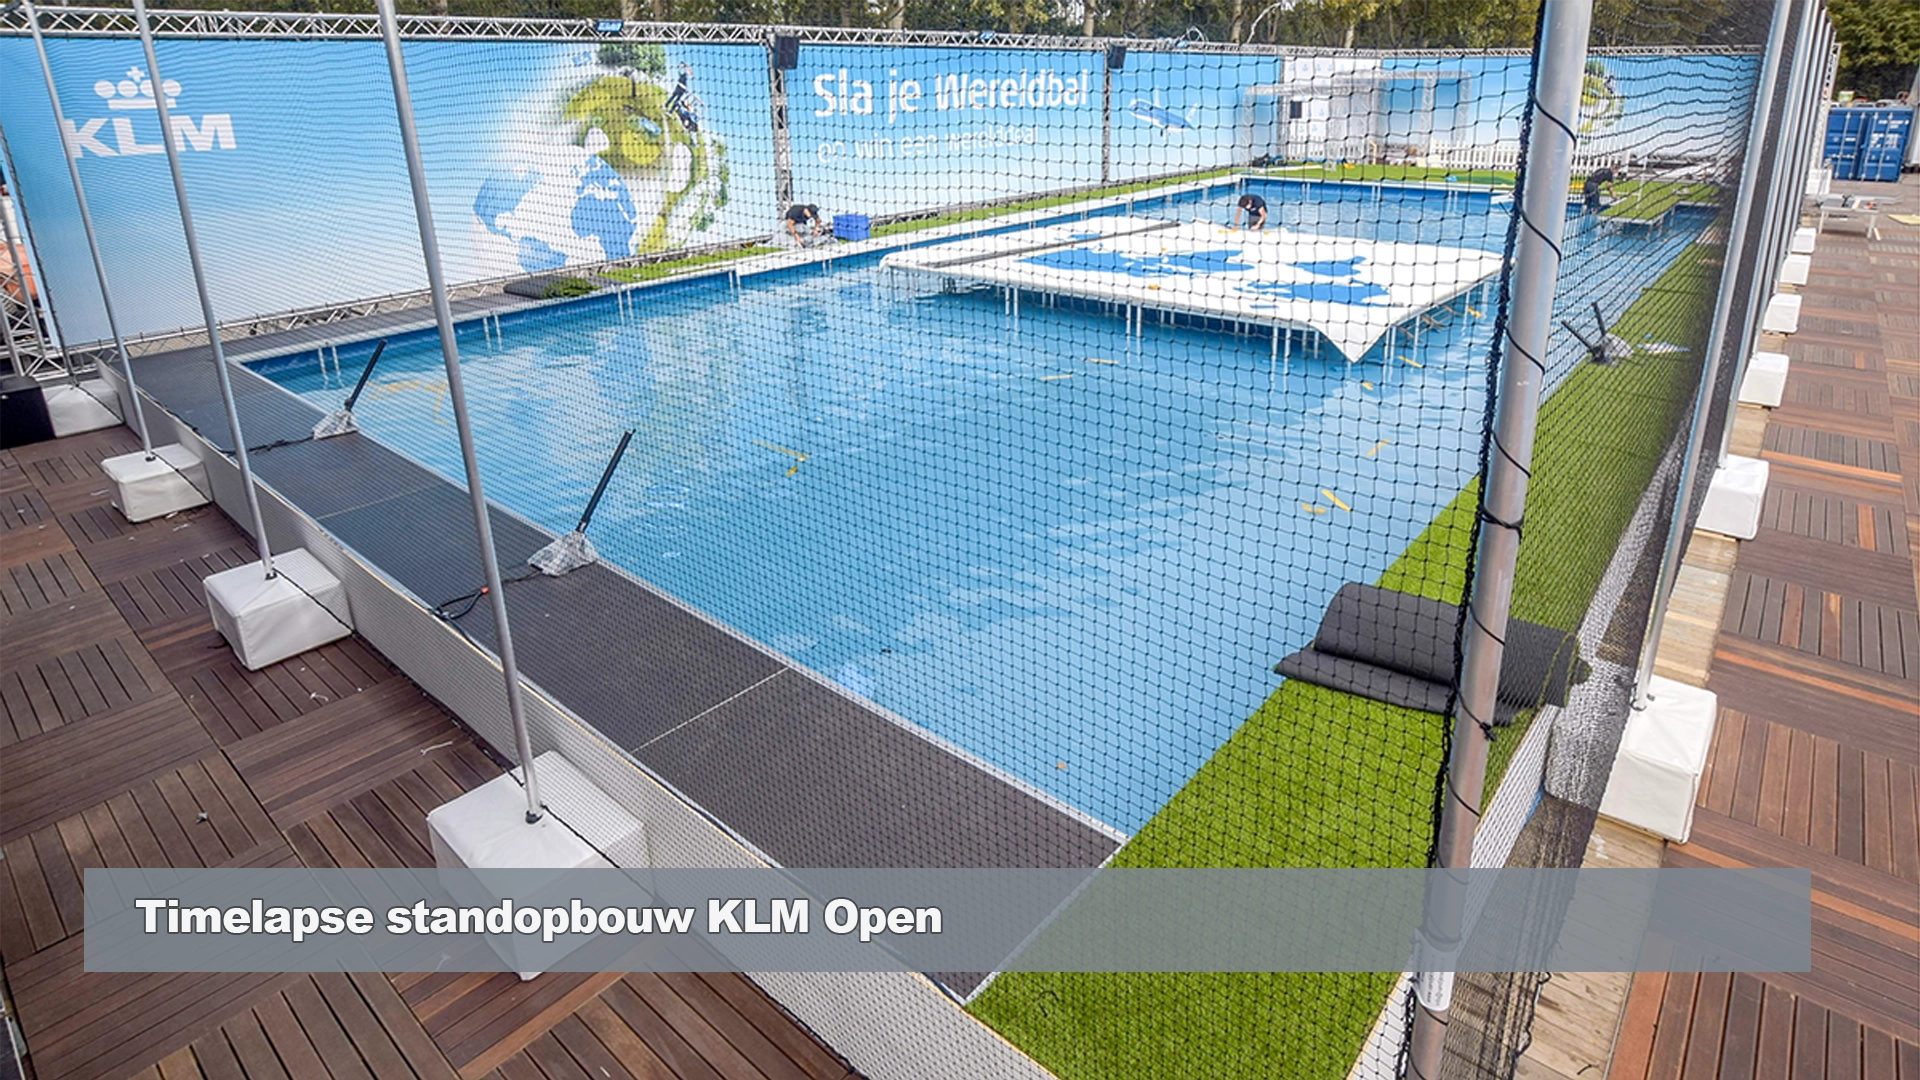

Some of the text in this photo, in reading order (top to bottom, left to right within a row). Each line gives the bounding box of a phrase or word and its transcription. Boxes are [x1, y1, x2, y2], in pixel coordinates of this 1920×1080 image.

[813, 68, 1089, 123] Sla je Wereldbal
[63, 113, 237, 158] KLM
[817, 141, 847, 163] en
[855, 132, 893, 159] win
[901, 133, 939, 156] een
